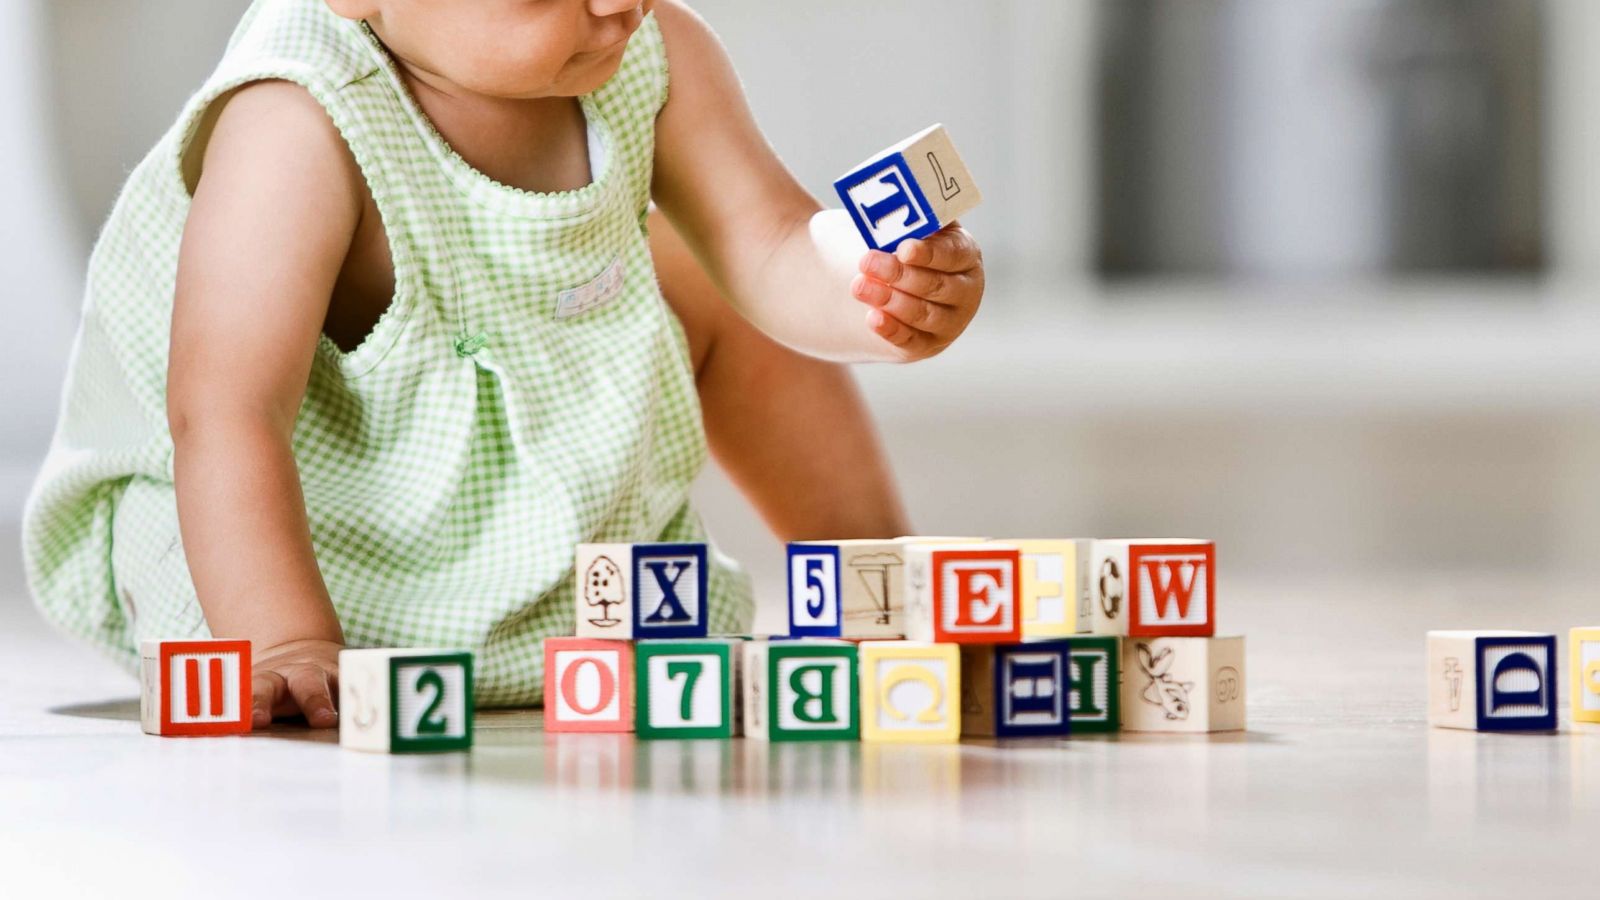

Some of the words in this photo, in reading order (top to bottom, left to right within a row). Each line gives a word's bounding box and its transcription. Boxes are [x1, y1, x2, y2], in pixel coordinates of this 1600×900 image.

[861, 172, 921, 229] T
[644, 561, 692, 623] X
[806, 559, 825, 619] 5
[954, 568, 1005, 626] E
[1139, 559, 1206, 619] W
[416, 668, 447, 734] 2
[667, 662, 703, 721] 7
[789, 664, 838, 722] B
[1492, 652, 1544, 713] D
